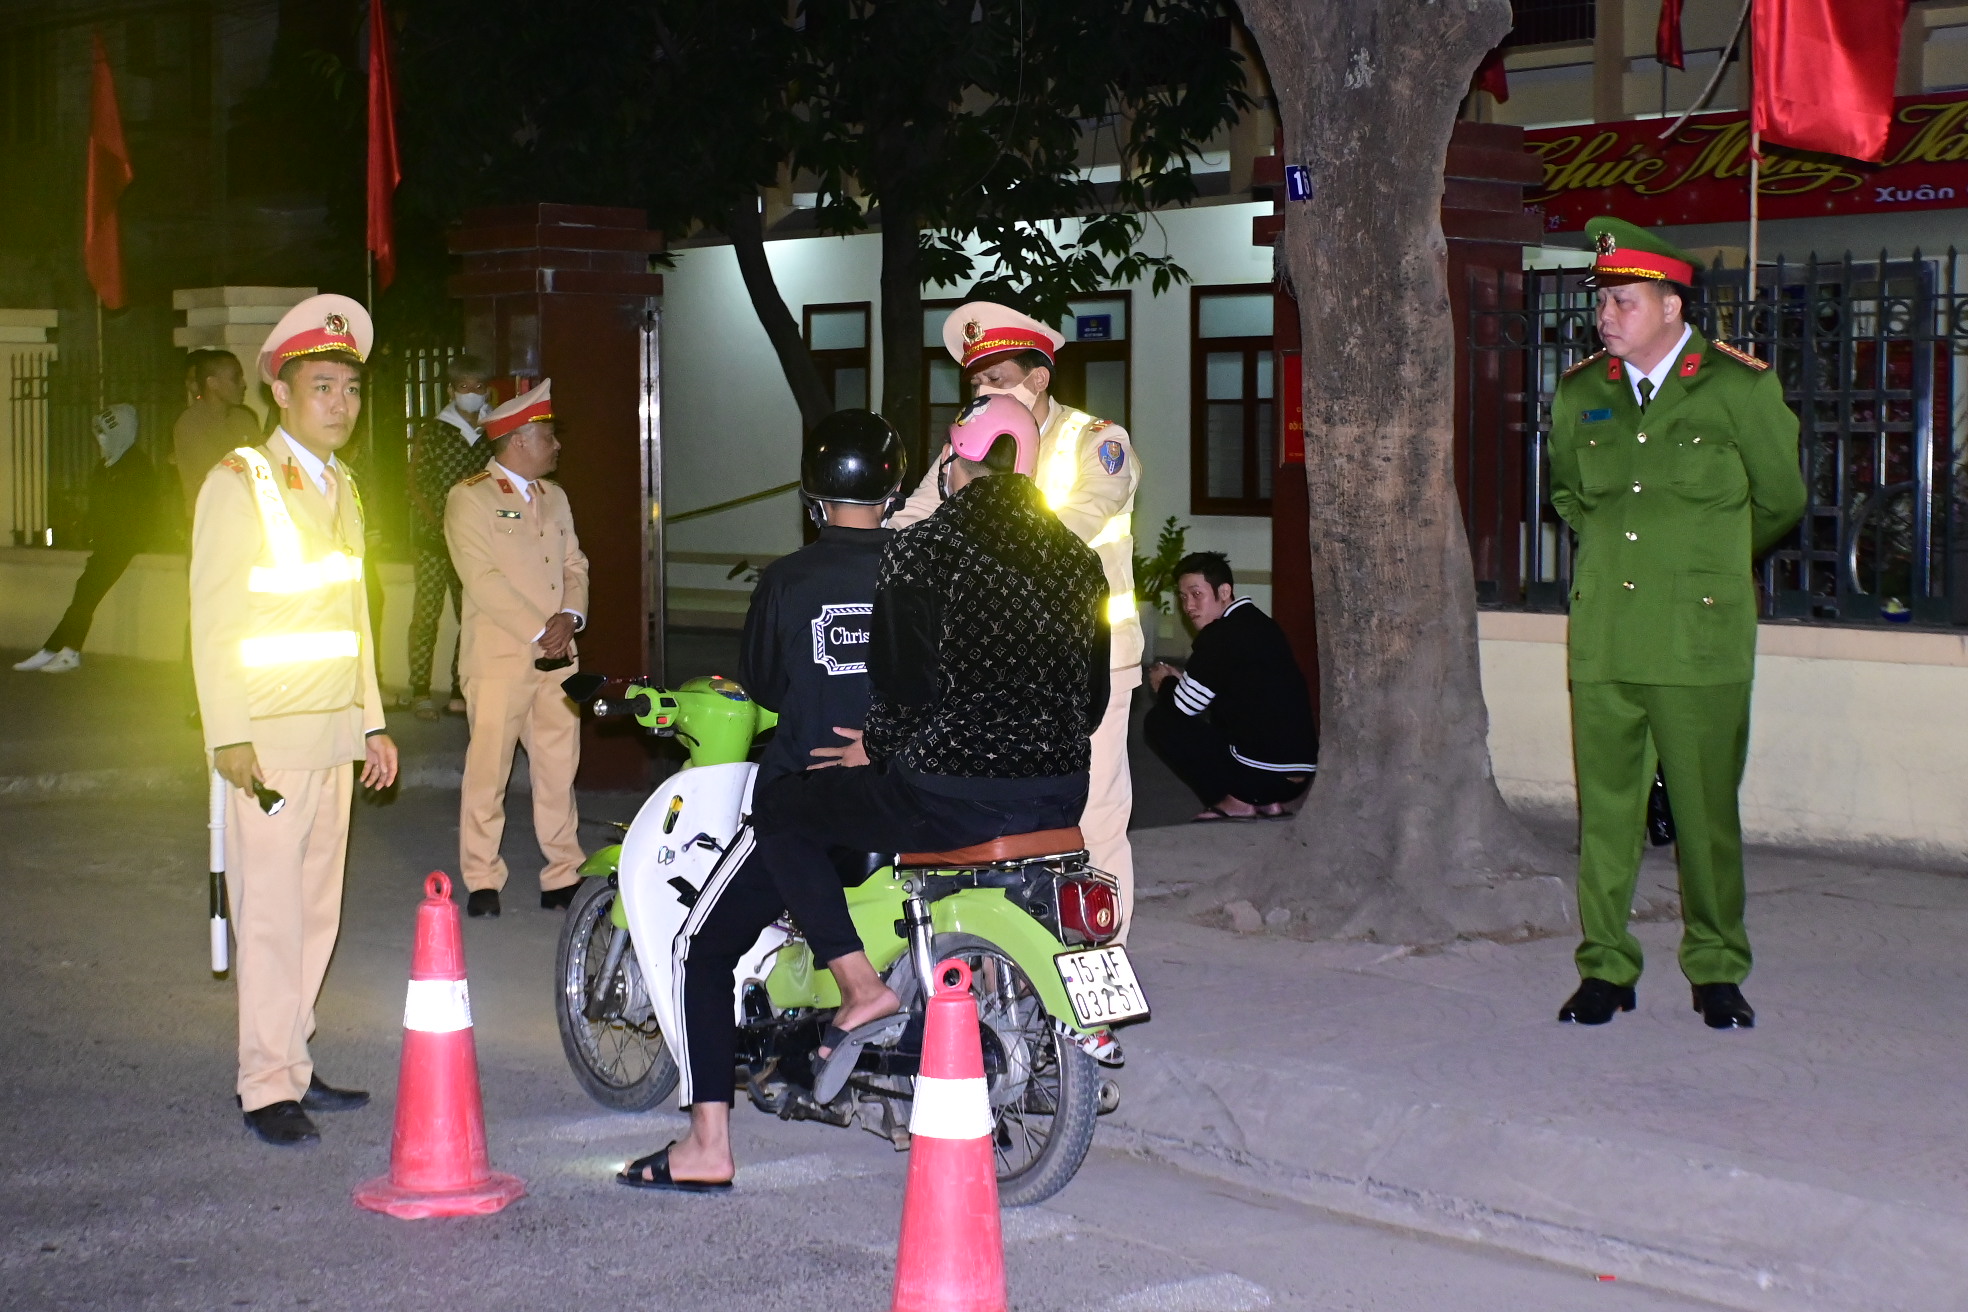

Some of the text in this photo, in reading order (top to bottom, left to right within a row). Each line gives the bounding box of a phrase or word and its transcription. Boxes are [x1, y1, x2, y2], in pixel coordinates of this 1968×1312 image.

[1873, 183, 1956, 203] Xuân
[829, 626, 871, 646] Chris
[1070, 951, 1121, 985] 15-AF
